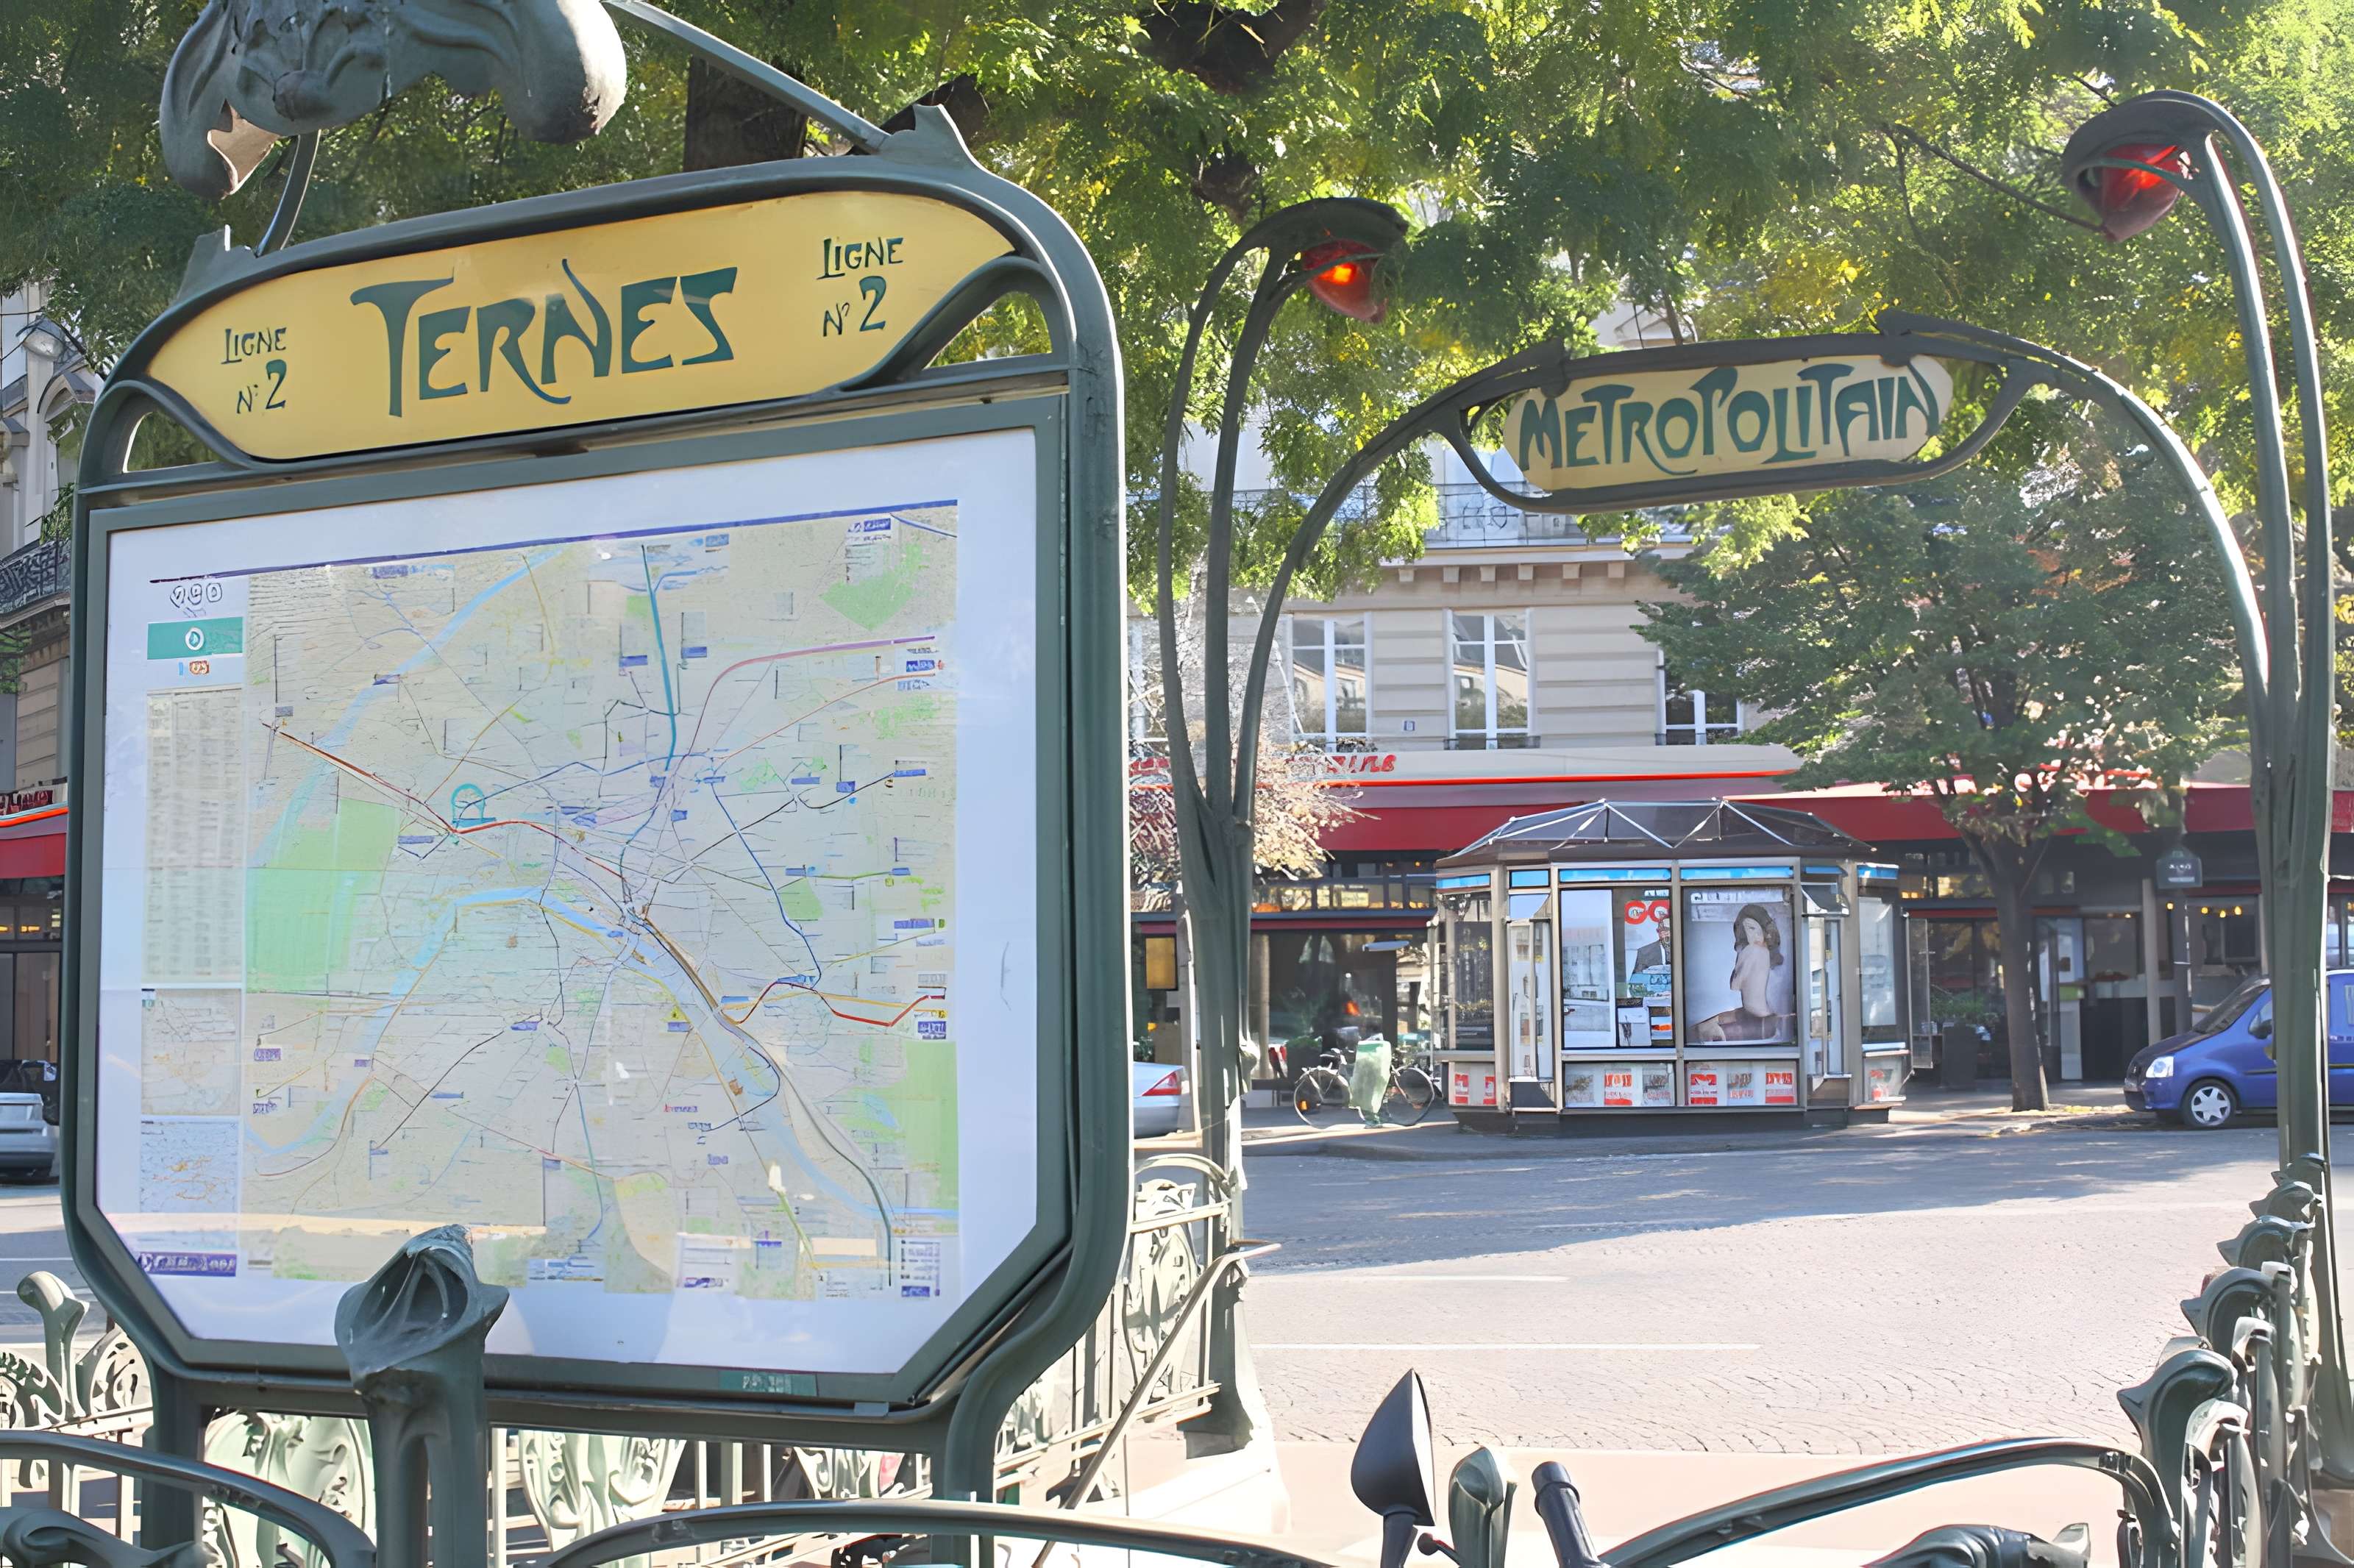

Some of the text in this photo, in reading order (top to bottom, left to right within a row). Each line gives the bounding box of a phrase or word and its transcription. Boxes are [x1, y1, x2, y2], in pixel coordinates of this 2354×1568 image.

[817, 237, 904, 280] LIGNE
[859, 276, 887, 332] 2
[221, 326, 288, 366] LIGNE
[350, 257, 739, 418] TERNES
[265, 358, 288, 410] 2
[1518, 360, 1941, 475] METROPOLITAIN
